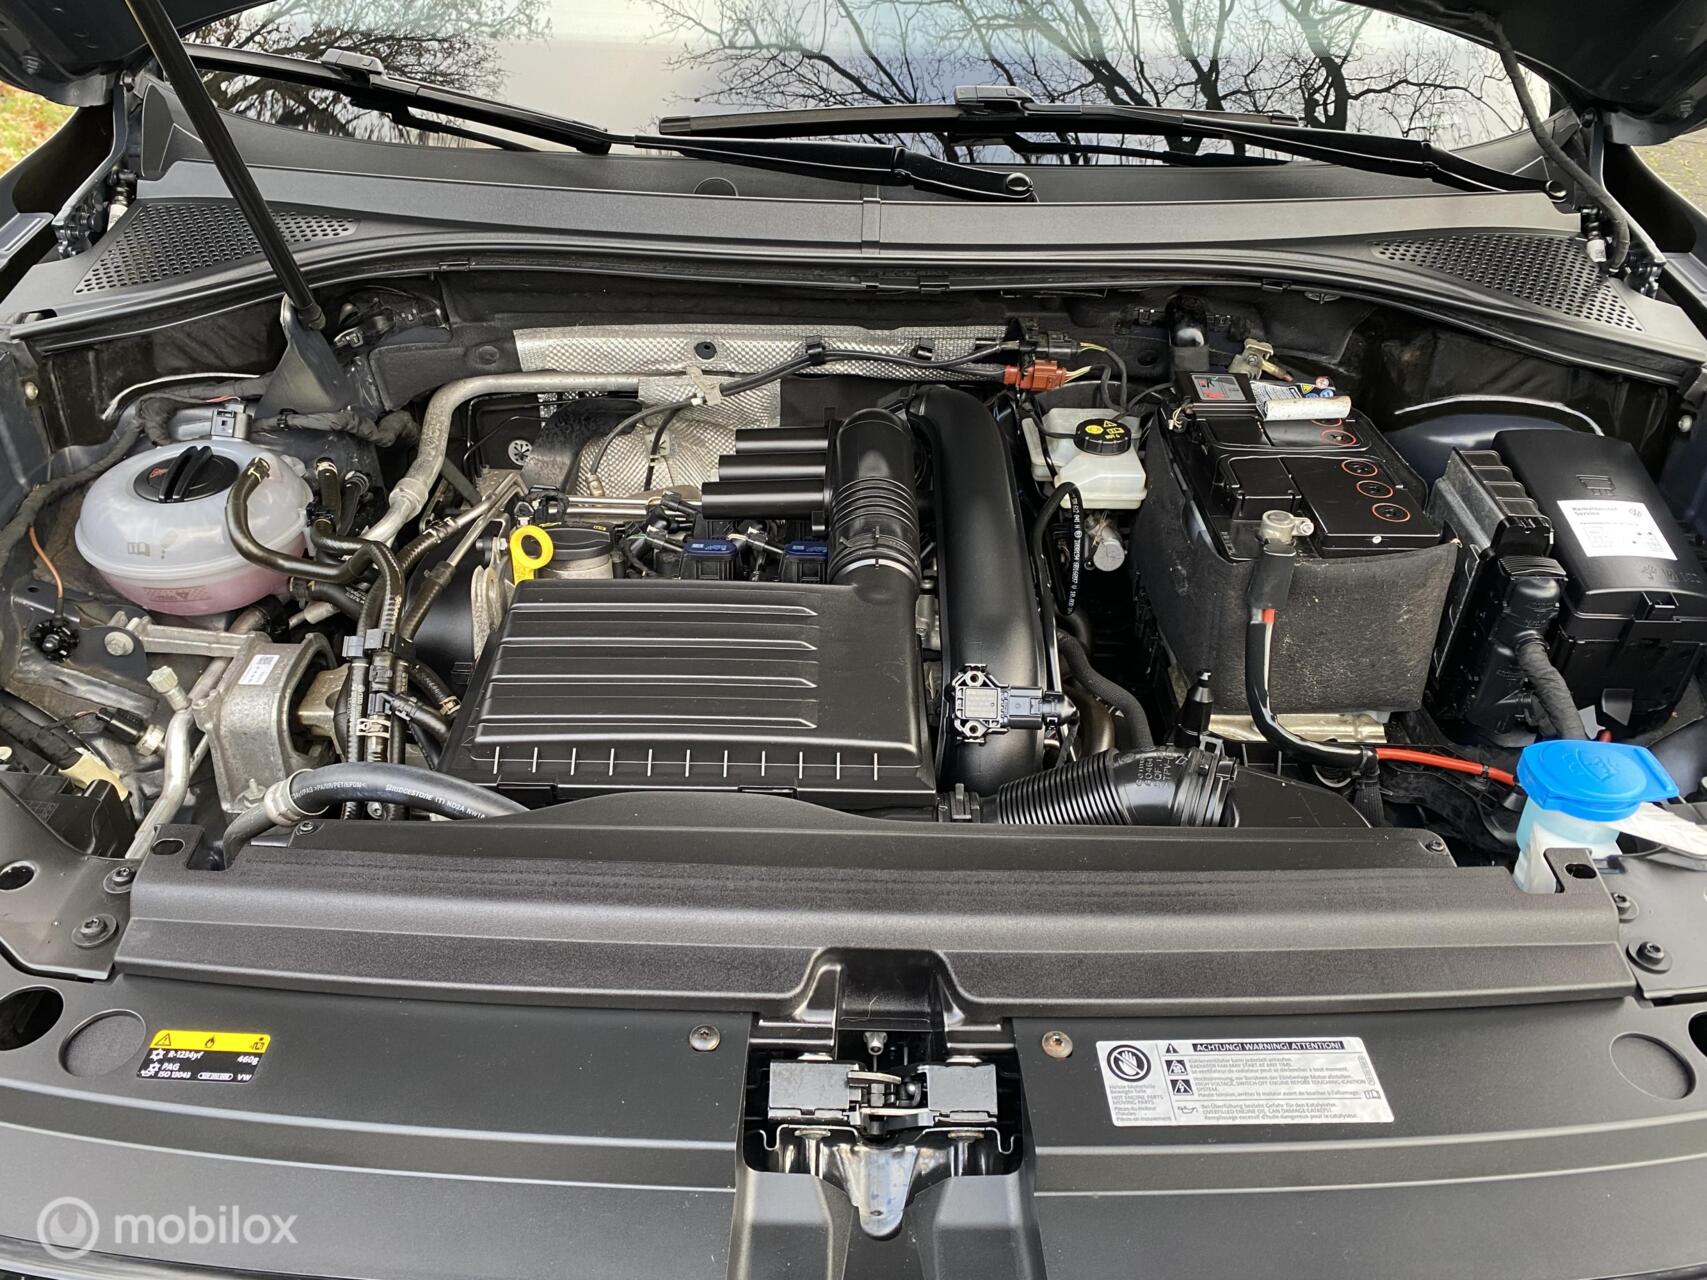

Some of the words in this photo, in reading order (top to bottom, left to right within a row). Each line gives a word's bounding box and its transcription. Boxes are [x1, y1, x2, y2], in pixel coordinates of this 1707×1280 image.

[385, 784, 433, 801] BRIDGESTONE
[1196, 1043, 1242, 1052] ACHTUNG!
[1243, 1042, 1290, 1051] WARNING!
[1291, 1041, 1342, 1051] ATTENTION!
[167, 1050, 205, 1061] R-1234yf
[237, 1055, 260, 1066] 460g
[161, 1063, 180, 1071] PAG
